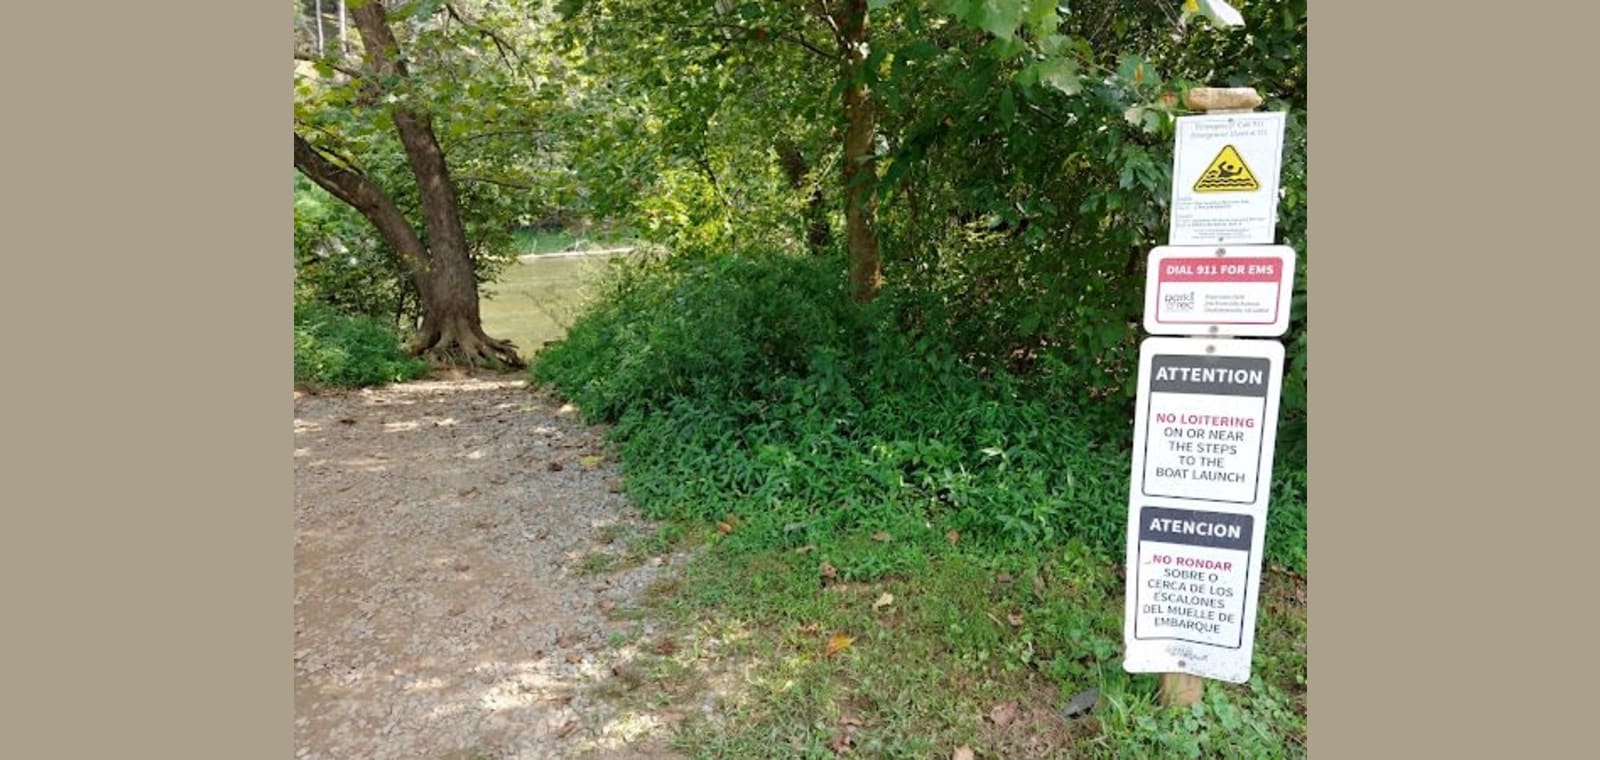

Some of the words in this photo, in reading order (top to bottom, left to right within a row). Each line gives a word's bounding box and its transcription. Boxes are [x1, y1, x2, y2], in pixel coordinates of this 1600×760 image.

[1166, 265, 1193, 275] DIAL
[1196, 265, 1218, 274] 911
[1220, 265, 1246, 275] FOR
[1247, 265, 1275, 275] EMS
[1155, 366, 1263, 385] ATTENTION
[1156, 413, 1177, 424] NO
[1180, 414, 1255, 428] LOITERING
[1164, 427, 1183, 438] ON
[1186, 428, 1205, 440] OR
[1208, 430, 1245, 442] NEAR
[1169, 440, 1193, 452] THE
[1196, 442, 1238, 456] STEPS
[1178, 455, 1196, 466] TO
[1200, 456, 1225, 469] THE
[1156, 467, 1189, 479] BOAT
[1191, 469, 1246, 484] LAUNCH
[1150, 518, 1241, 539] ATENCION
[1152, 554, 1172, 565] NO
[1176, 556, 1232, 572] RONDAR
[1164, 568, 1206, 582] SOBRE
[1208, 573, 1219, 583] O
[1147, 579, 1187, 592] CERCA
[1189, 583, 1206, 594] DE
[1209, 586, 1234, 598] LOS
[1153, 592, 1225, 609] ESCALONES
[1142, 604, 1164, 615] DEL
[1167, 606, 1215, 621] MUELLE
[1218, 612, 1236, 625] DE
[1154, 617, 1221, 633] EMBARQUE
